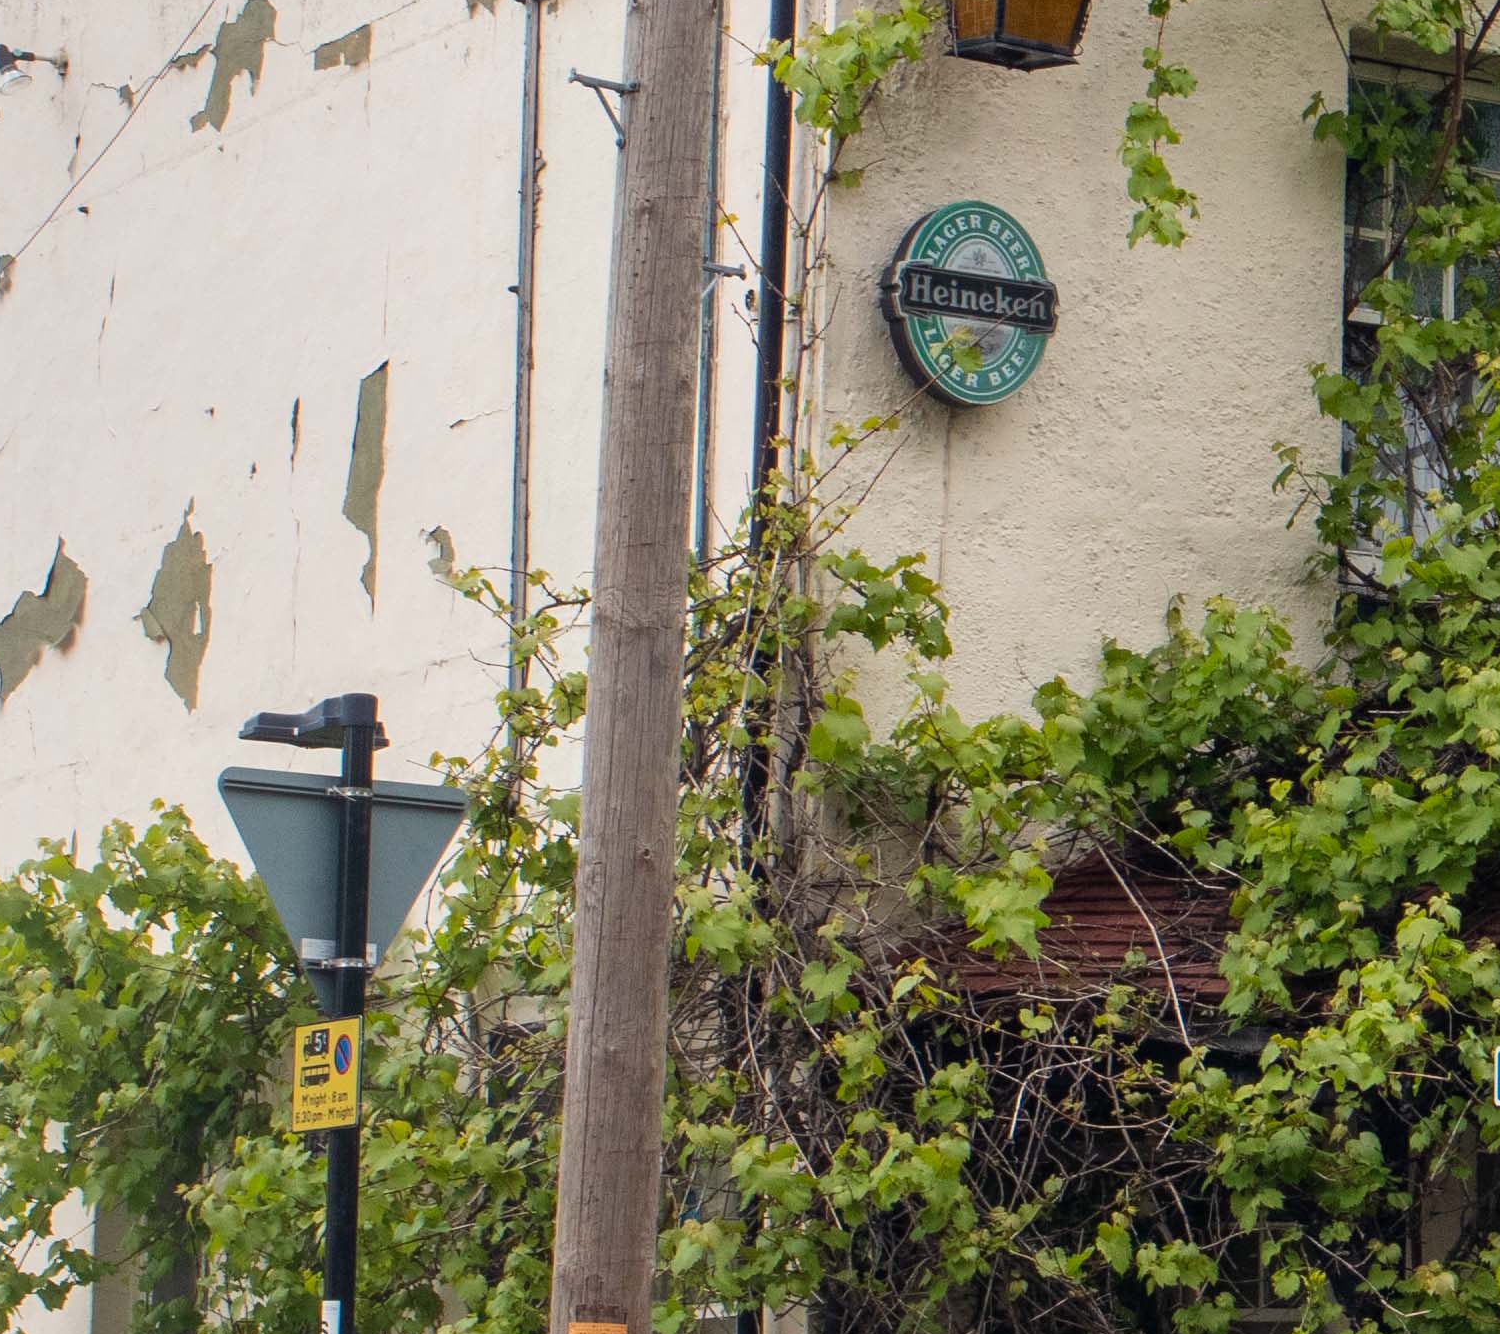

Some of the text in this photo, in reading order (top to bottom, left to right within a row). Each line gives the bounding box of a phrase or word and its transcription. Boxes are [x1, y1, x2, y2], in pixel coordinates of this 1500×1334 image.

[927, 214, 1031, 270] LAGER BEER
[909, 272, 1047, 321] Heineken
